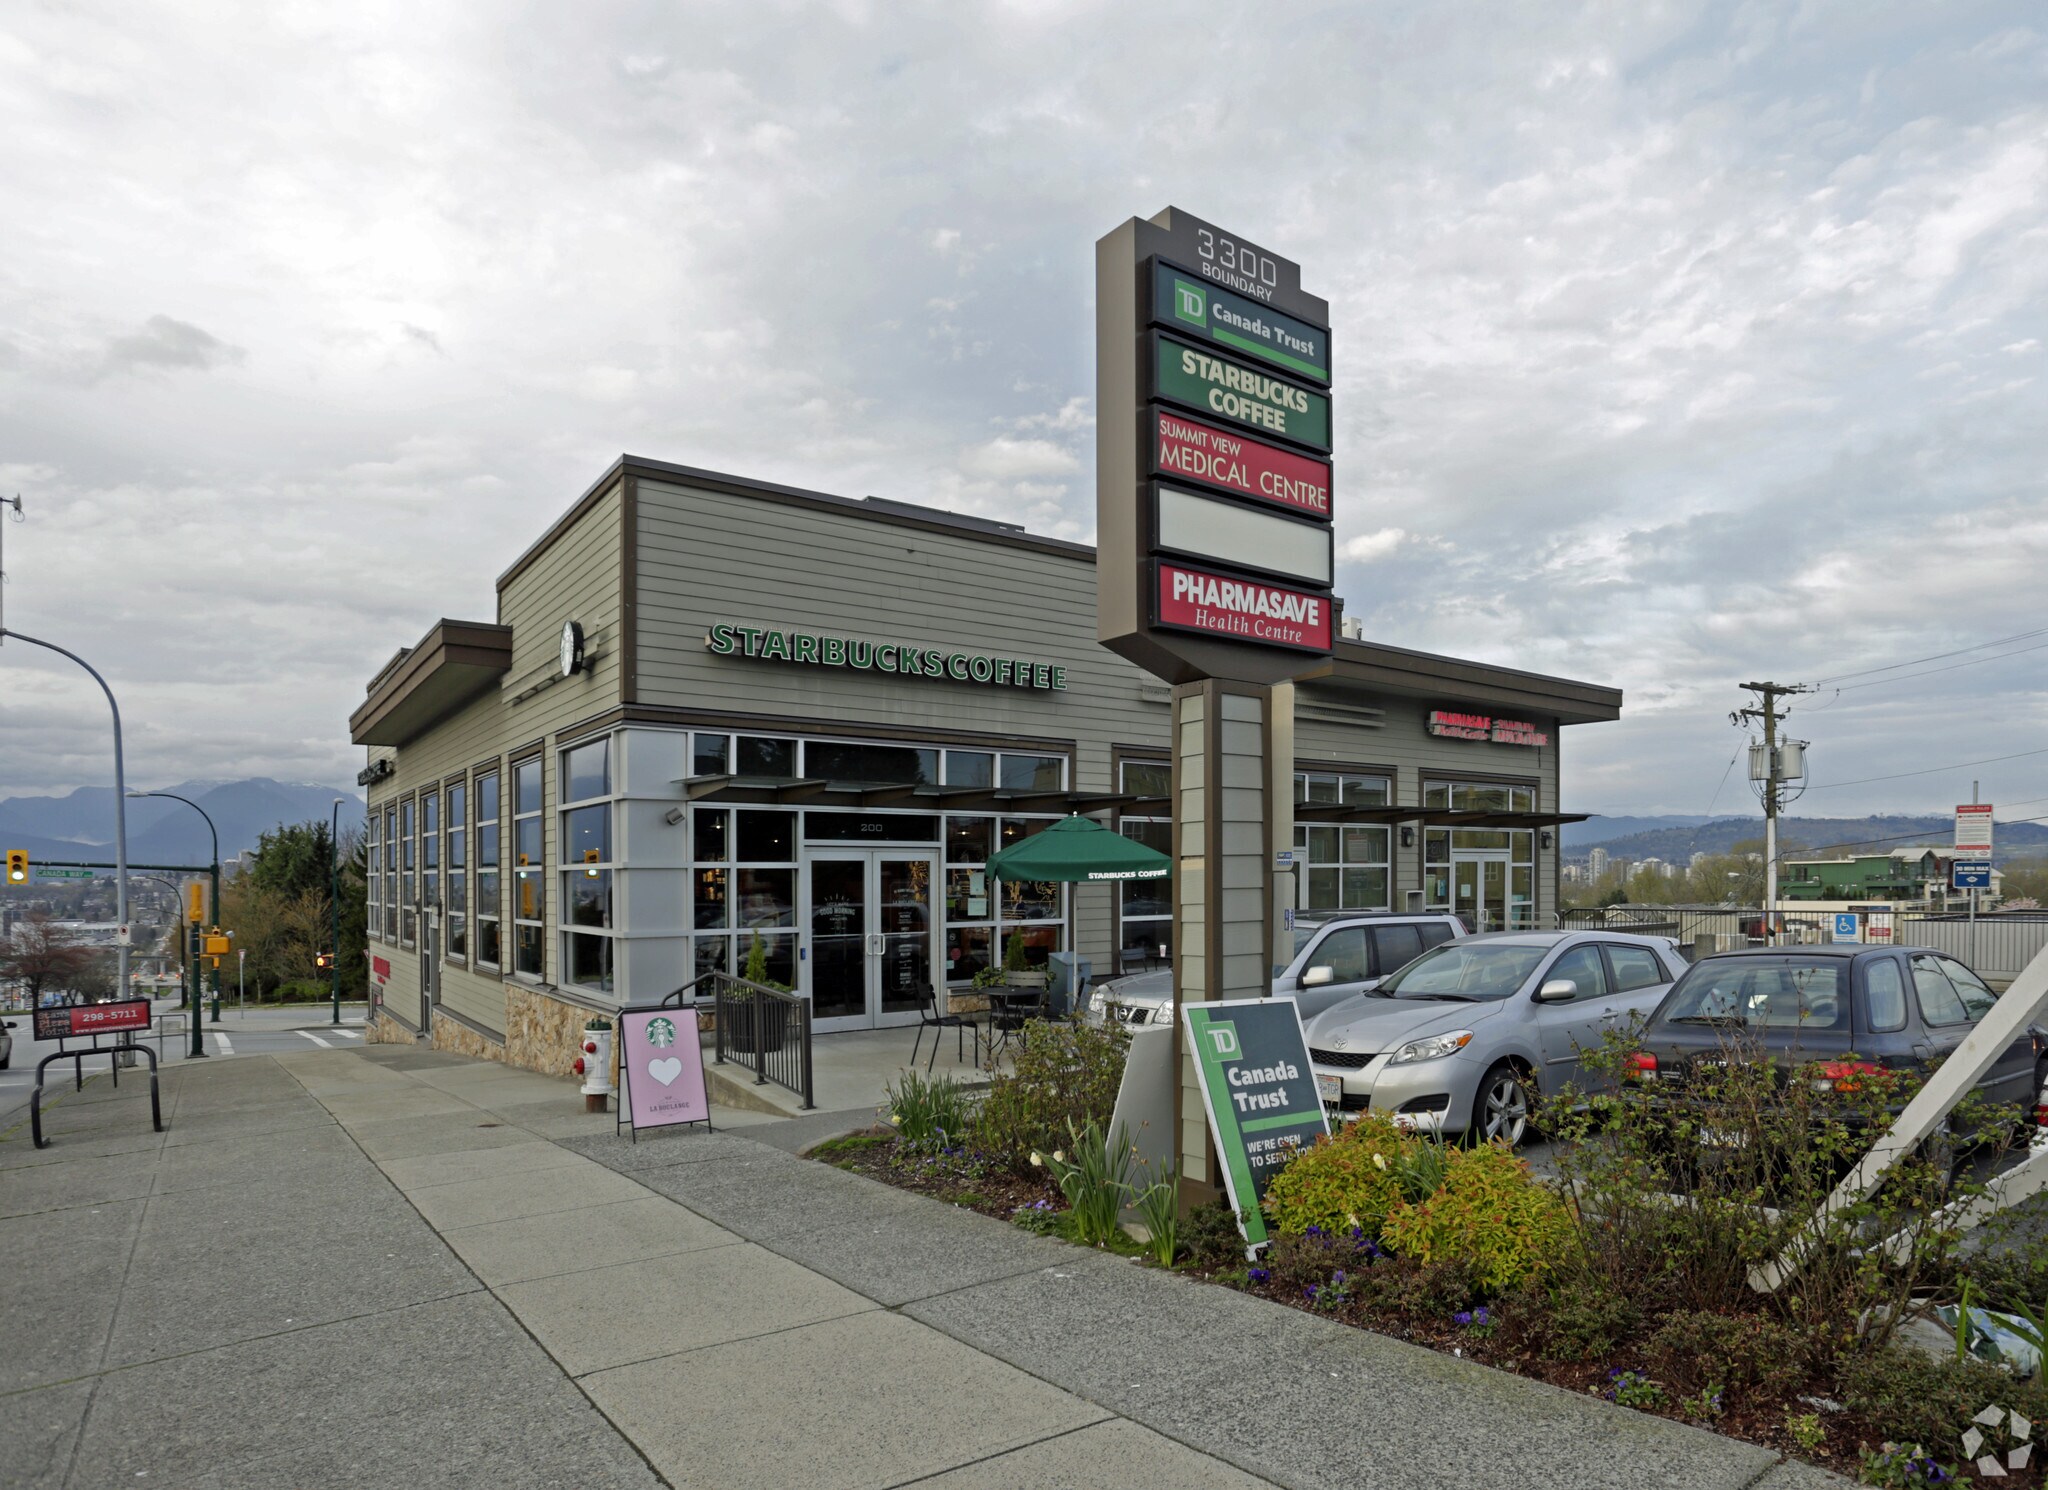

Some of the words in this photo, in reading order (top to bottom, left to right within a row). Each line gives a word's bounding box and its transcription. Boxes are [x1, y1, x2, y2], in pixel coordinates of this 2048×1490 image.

[1197, 228, 1276, 287] 3300
[1202, 262, 1272, 302] BOUNDARY
[1178, 287, 1203, 317] TD
[1212, 302, 1270, 339] Canada
[1274, 326, 1315, 357] Trust
[1182, 349, 1308, 413] STARBUCKS
[1208, 388, 1286, 433] COFFEE
[1160, 419, 1208, 447] SUMMIT
[1210, 434, 1241, 457] VIEW
[1160, 441, 1250, 488] MEDICAL
[1259, 471, 1327, 510] CENTRE
[1173, 571, 1319, 626] PHARMASAVE
[1195, 608, 1249, 633] Health
[1254, 619, 1302, 643] Centre
[860, 823, 883, 832] 200
[1088, 871, 1136, 880] STARBUCKS
[1137, 869, 1167, 878] COFFEE
[83, 1010, 138, 1022] 298-5711
[1208, 1028, 1236, 1053] TD
[1228, 1061, 1299, 1087] Canada
[1233, 1086, 1289, 1112] Trust
[1247, 1138, 1276, 1154] WE'RE
[1251, 1156, 1264, 1168] TO
